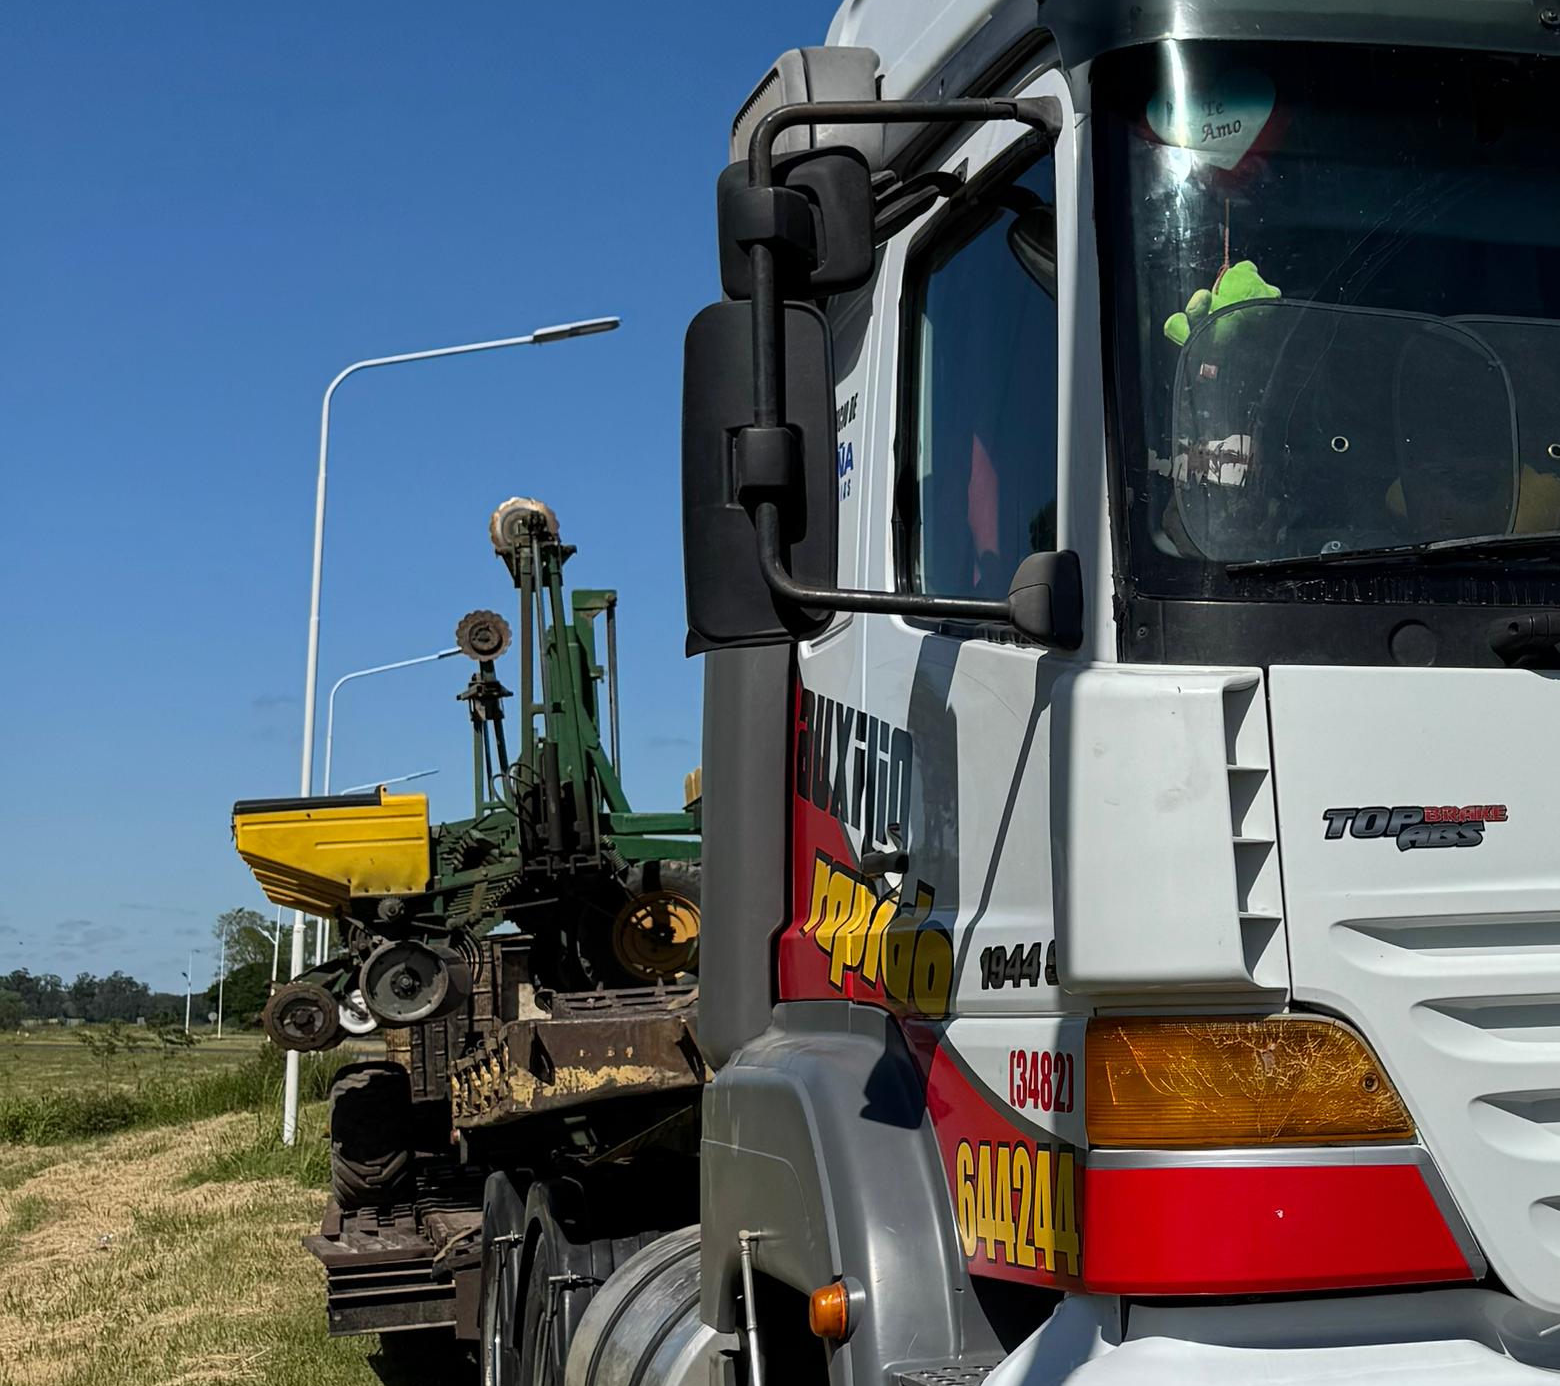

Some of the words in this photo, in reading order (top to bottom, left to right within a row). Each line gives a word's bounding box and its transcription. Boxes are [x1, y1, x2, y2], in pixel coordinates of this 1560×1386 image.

[1202, 120, 1241, 142] Amo
[1323, 806, 1424, 840] TOP
[1424, 805, 1508, 822] BRAKE
[1396, 821, 1485, 852] ABS
[980, 942, 1042, 990] 1944
[1009, 1050, 1074, 1113] (3482)
[956, 1137, 1081, 1276] 644244
